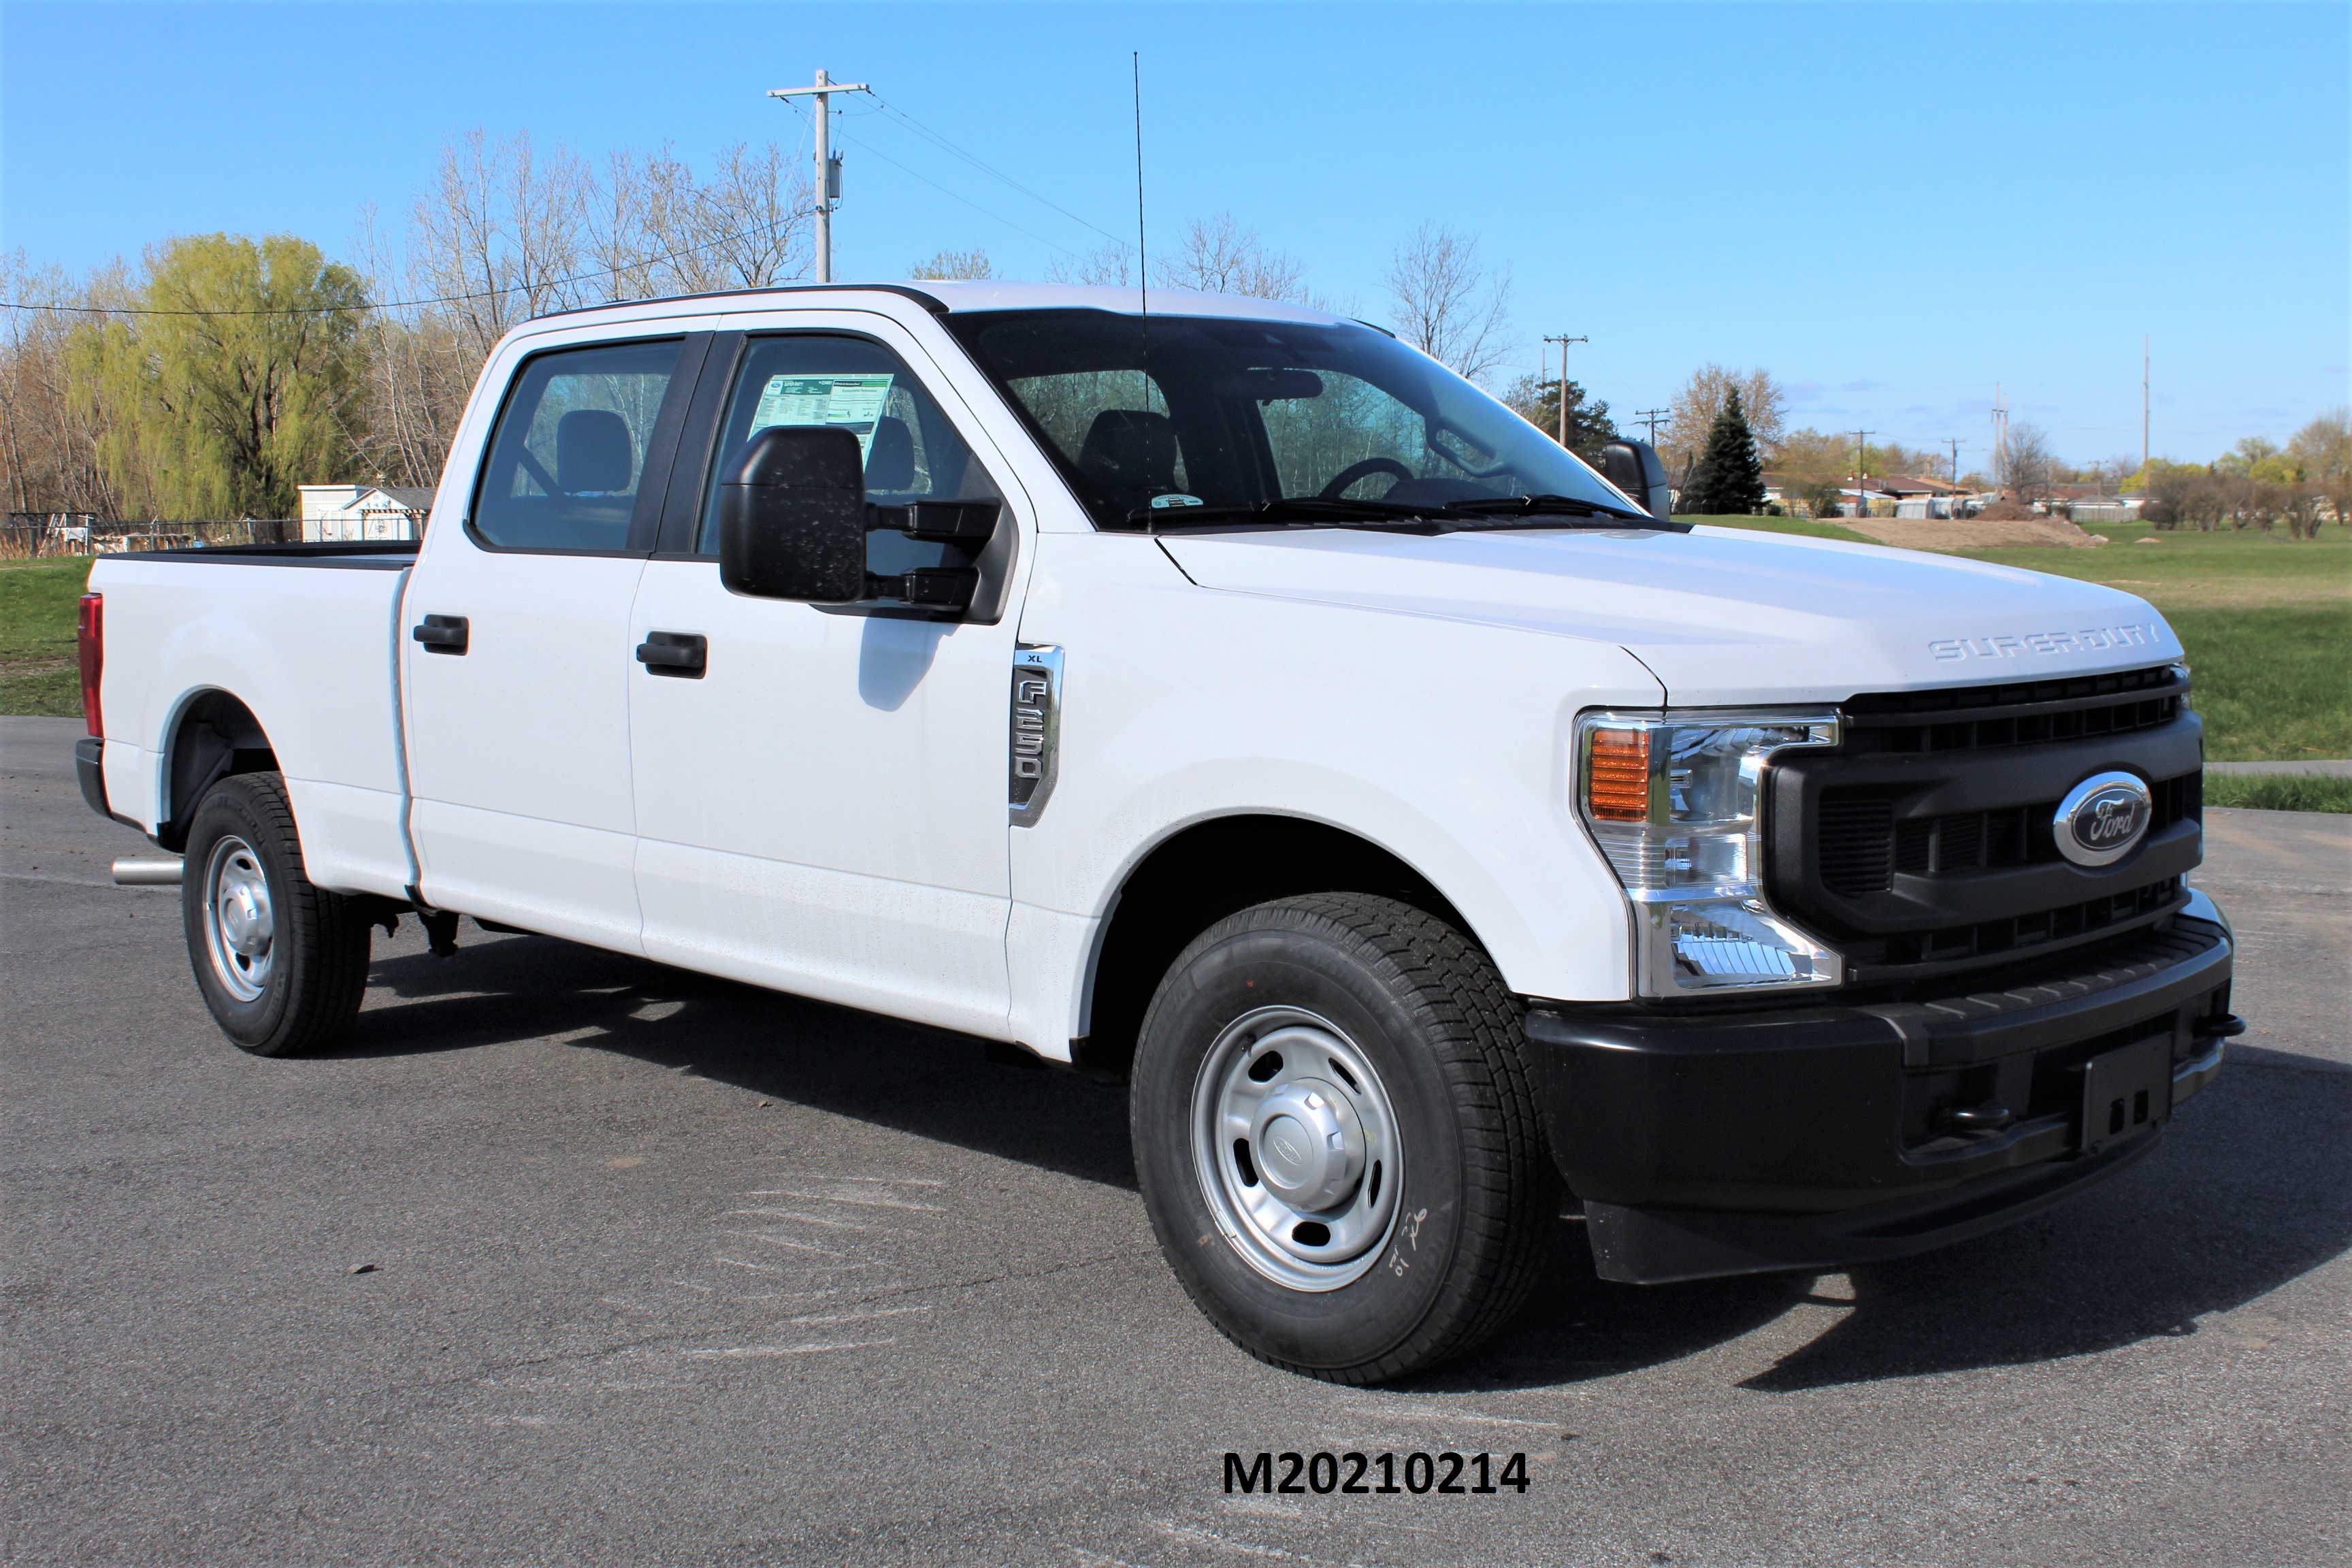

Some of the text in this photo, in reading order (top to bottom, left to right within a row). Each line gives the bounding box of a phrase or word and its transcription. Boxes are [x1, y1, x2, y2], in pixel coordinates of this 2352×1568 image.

[1028, 655, 1043, 664] XL
[1928, 623, 2160, 662] SUPER DUTY
[1015, 681, 1047, 779] F250
[2091, 798, 2137, 840] Ford
